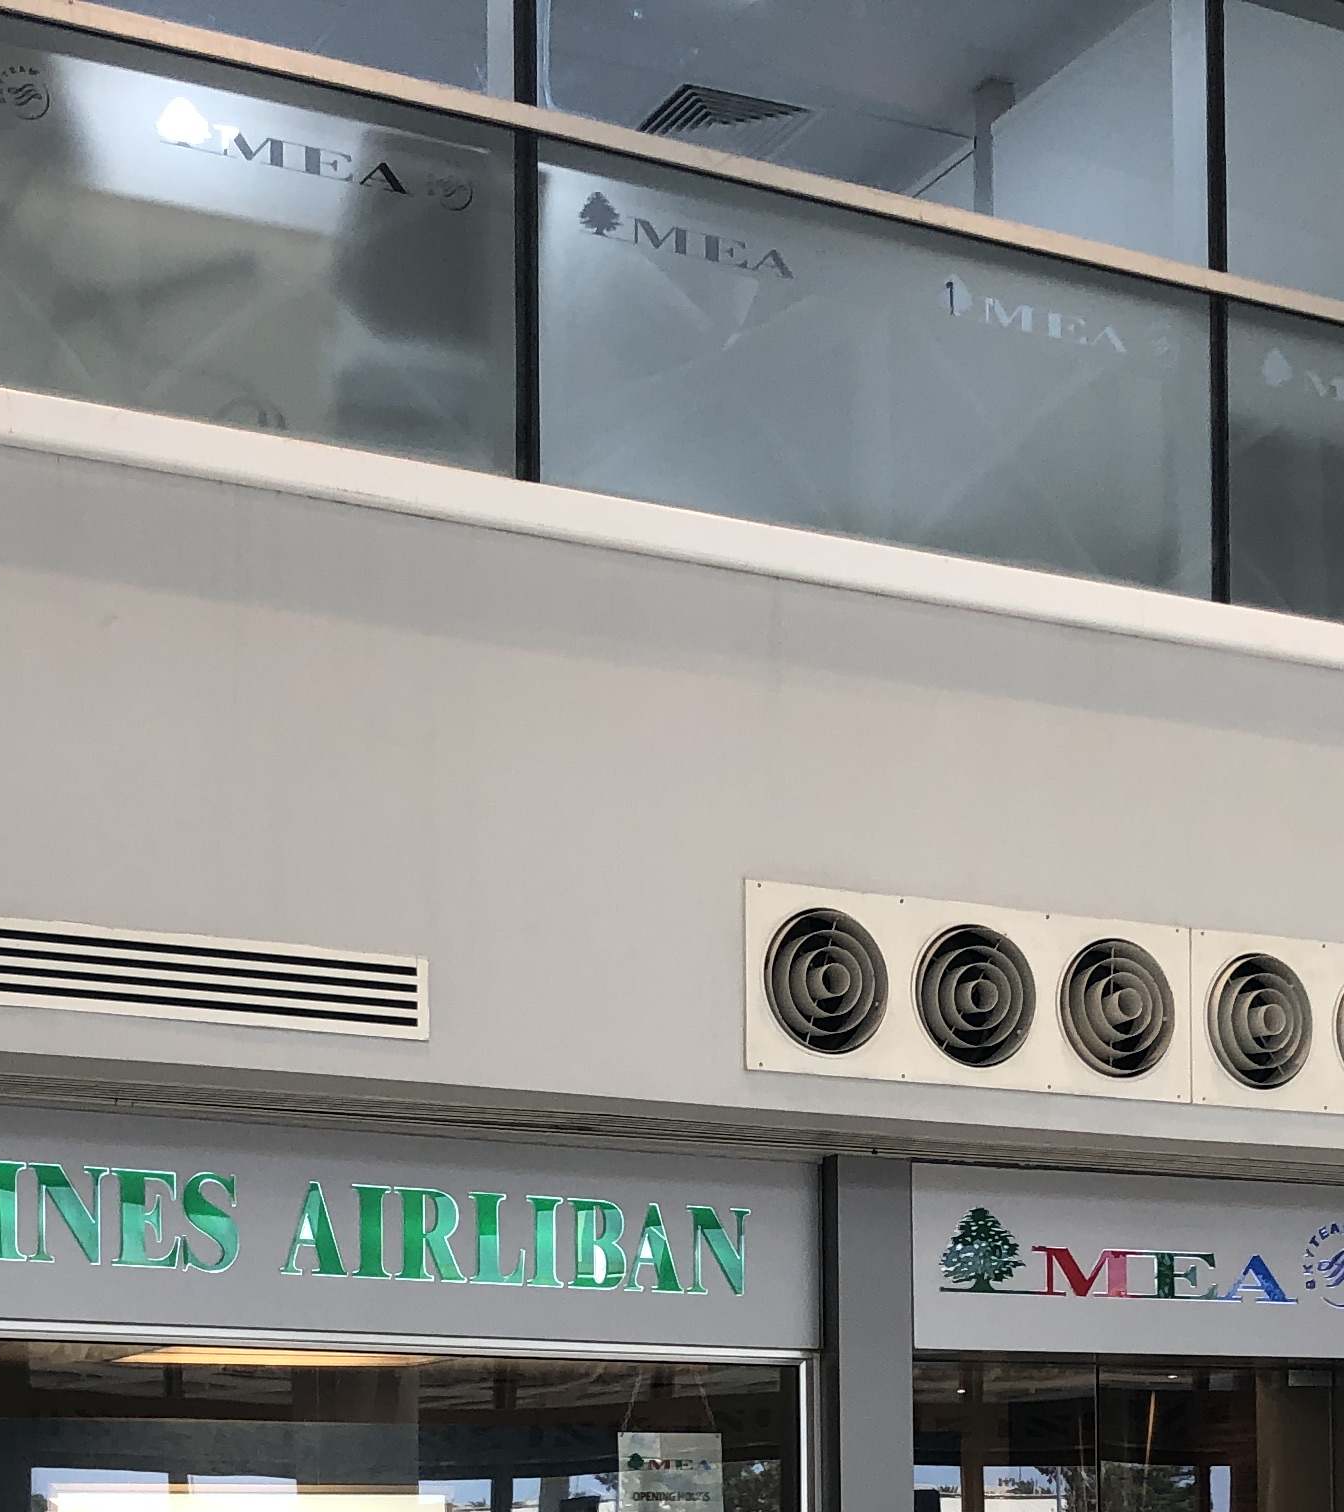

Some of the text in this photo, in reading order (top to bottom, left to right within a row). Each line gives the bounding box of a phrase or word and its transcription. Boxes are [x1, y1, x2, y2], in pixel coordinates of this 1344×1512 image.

[213, 123, 414, 197] MEA
[627, 215, 795, 280] MEA
[985, 297, 1127, 353] MEA
[279, 1181, 751, 1296] AIRLIBAN
[1032, 1245, 1298, 1304] MEA
[647, 1459, 712, 1471] MEA
